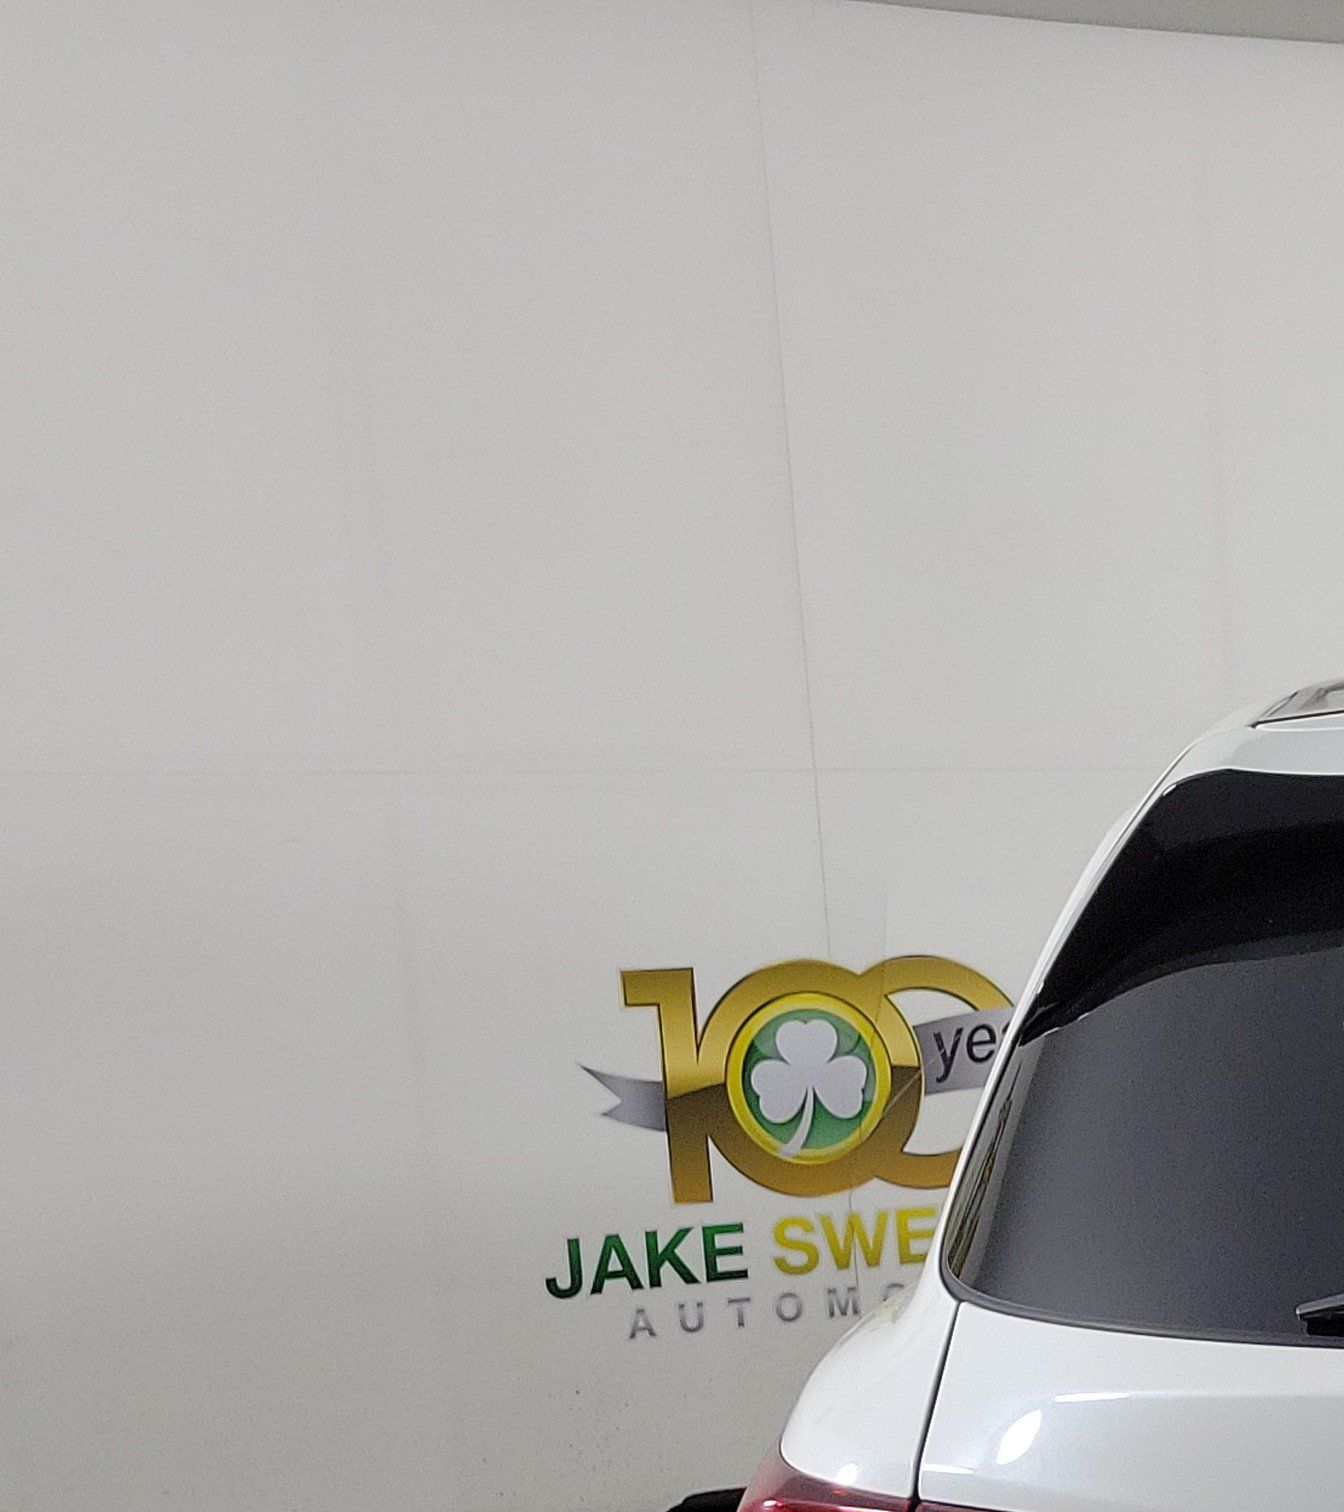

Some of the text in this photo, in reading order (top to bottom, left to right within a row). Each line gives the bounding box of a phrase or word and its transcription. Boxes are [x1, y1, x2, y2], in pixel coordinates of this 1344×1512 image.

[932, 1022, 1010, 1084] ye
[545, 1207, 938, 1300] JAKE SWE
